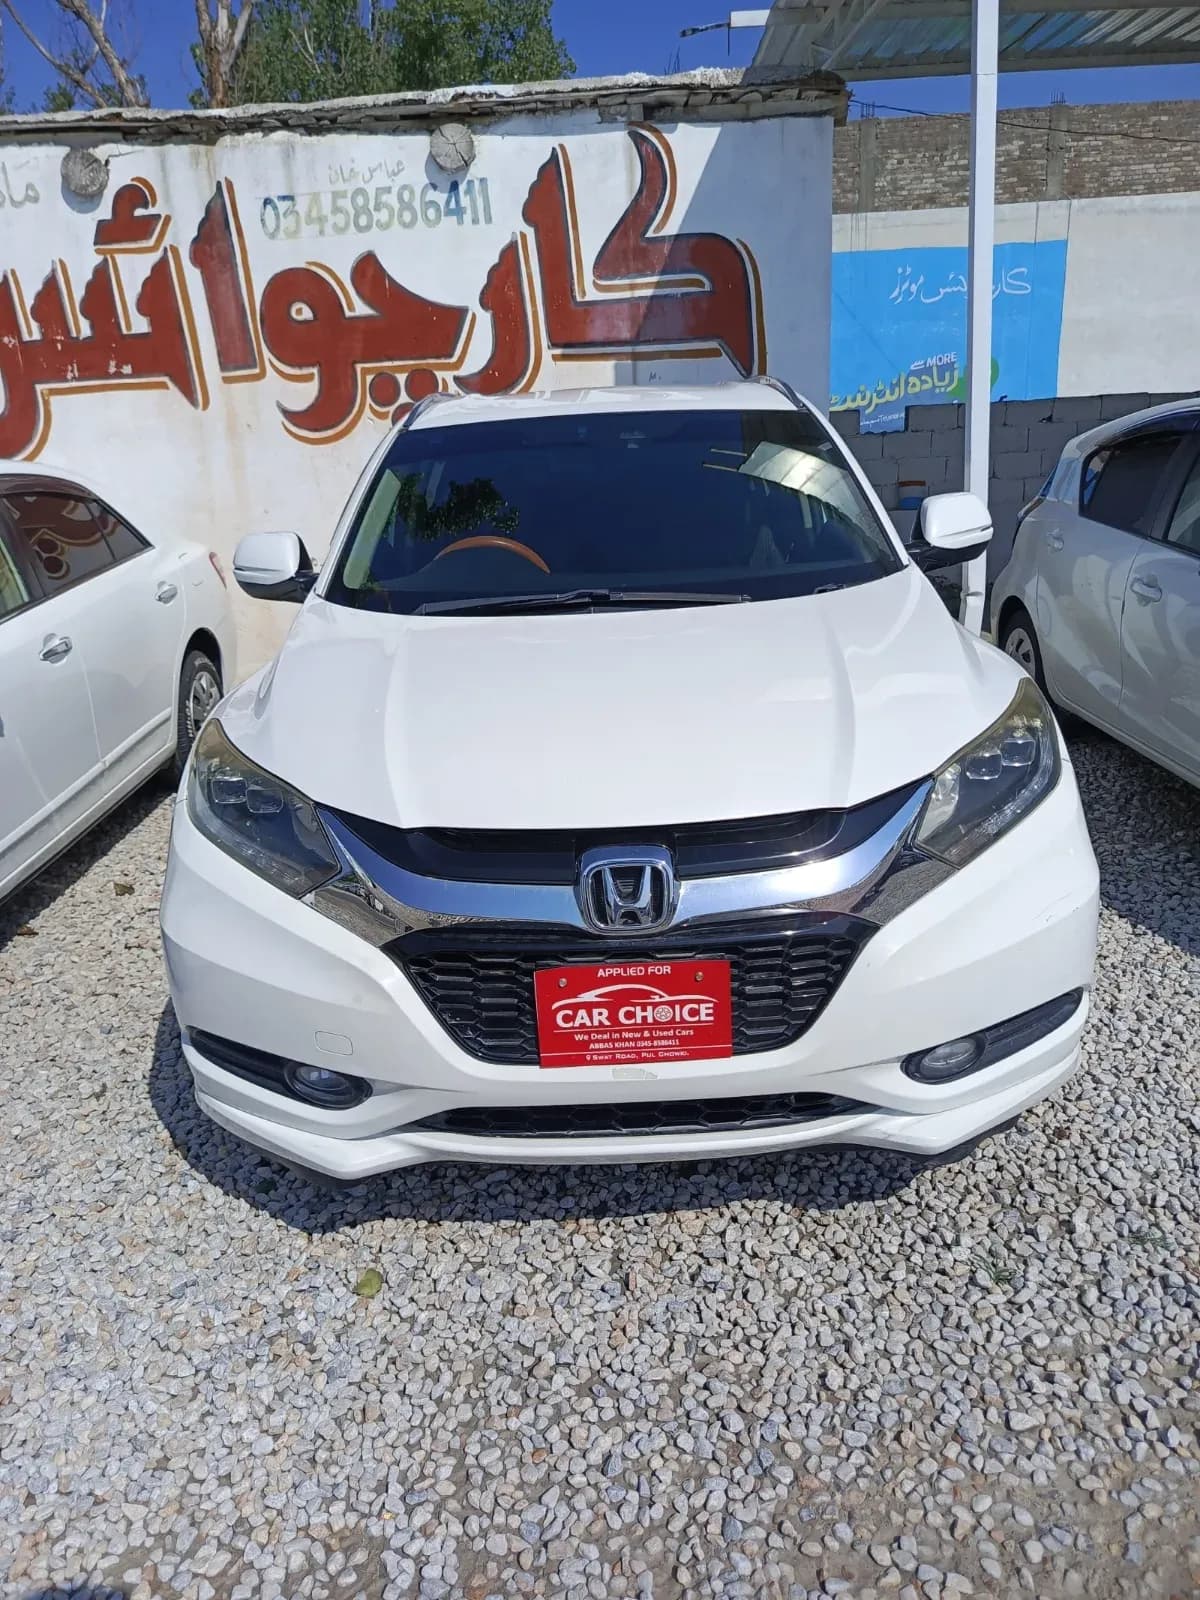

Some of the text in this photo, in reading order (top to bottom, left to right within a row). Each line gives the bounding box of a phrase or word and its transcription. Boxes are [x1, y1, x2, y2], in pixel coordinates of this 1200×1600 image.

[260, 177, 493, 240] 03458586411
[453, 124, 768, 395] کار
[926, 352, 957, 367] MORE
[597, 965, 671, 978] APPLIED FOR
[556, 1003, 714, 1027] CAR CHOICE
[574, 1032, 589, 1041] We
[591, 1031, 610, 1040] Deal
[612, 1031, 620, 1040] in
[622, 1030, 641, 1039] New
[653, 1028, 674, 1037] Used
[675, 1027, 694, 1036] Cars
[589, 1041, 614, 1050] ABBAS
[614, 1040, 636, 1049] KHAN
